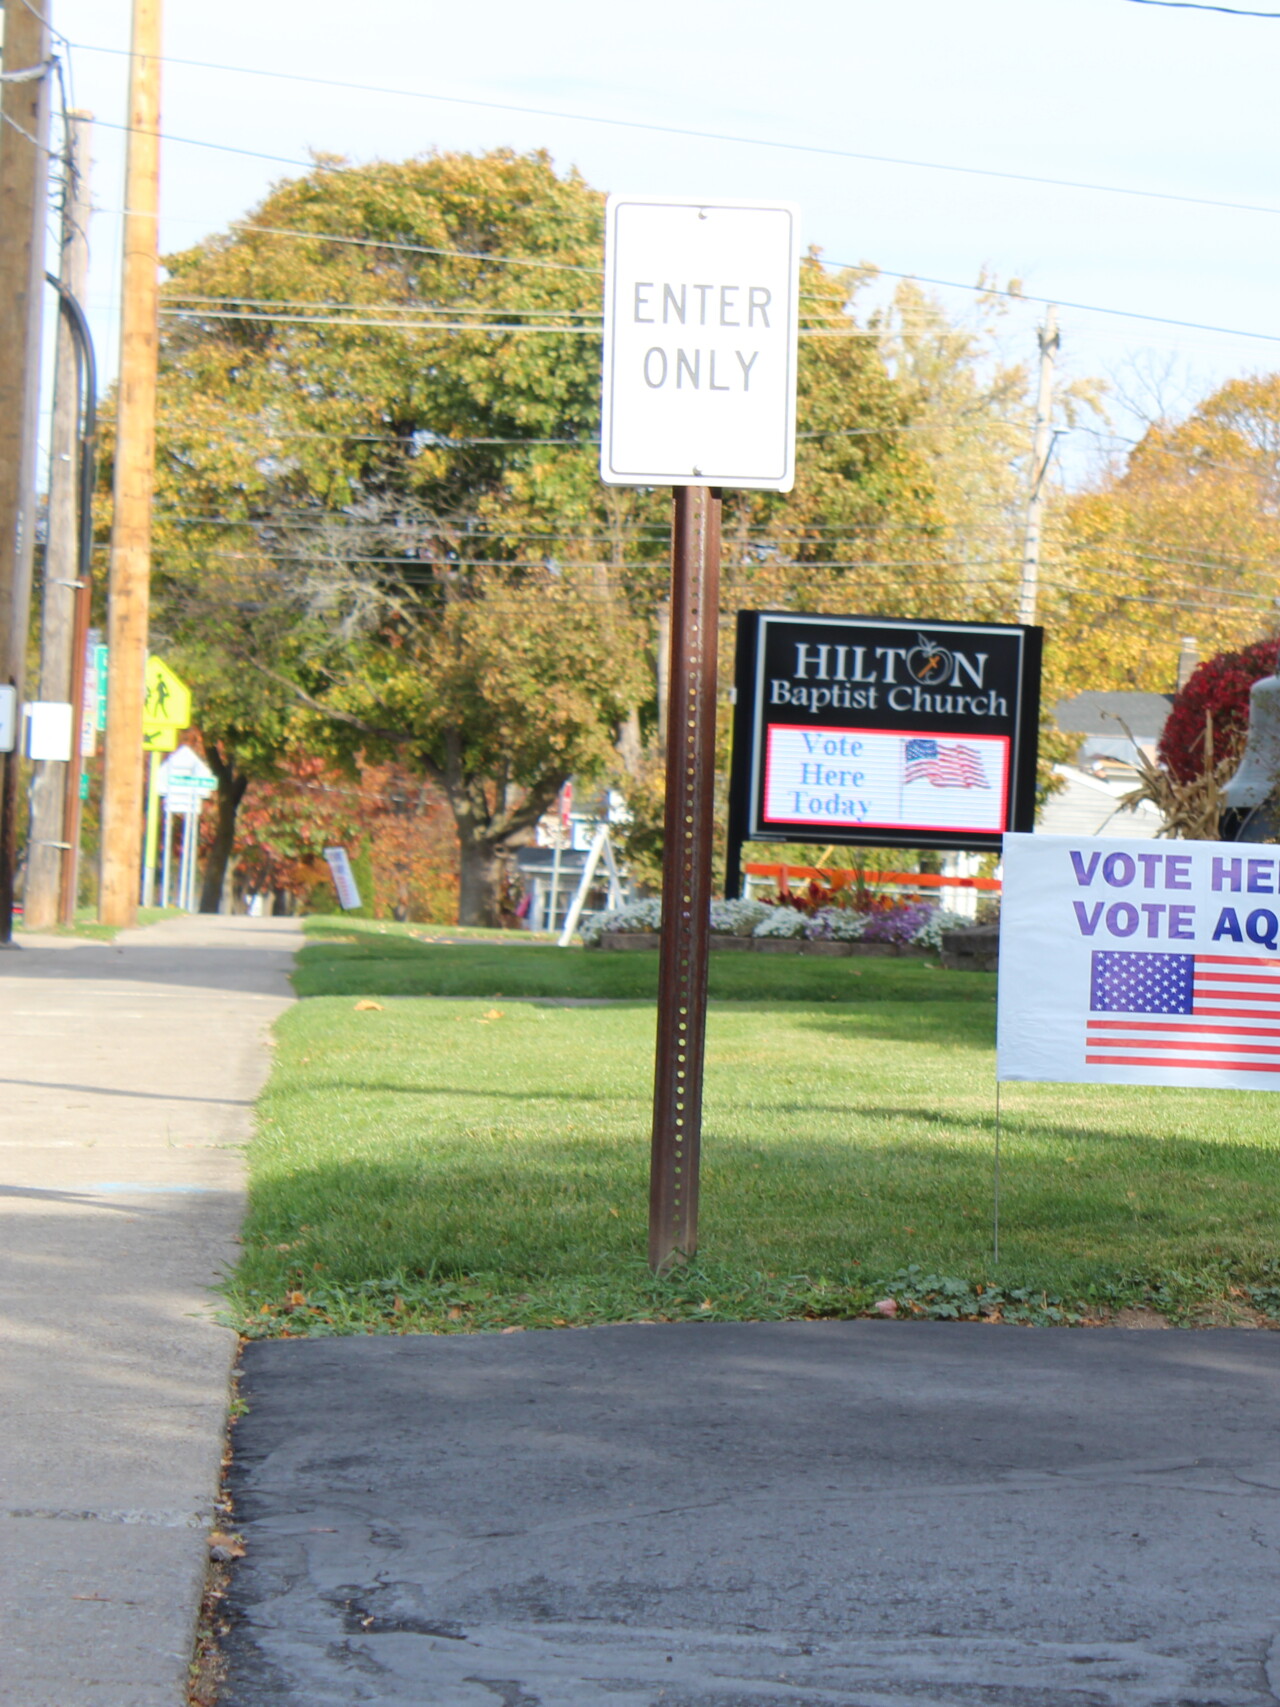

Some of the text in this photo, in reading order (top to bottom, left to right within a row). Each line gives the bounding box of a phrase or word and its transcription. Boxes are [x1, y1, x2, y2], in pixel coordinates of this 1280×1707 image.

[634, 282, 772, 328] ENTER
[643, 346, 759, 391] ONLY
[770, 679, 1009, 717] Baptist Church
[801, 732, 864, 757] Vote
[799, 762, 866, 787] Here
[787, 791, 872, 823] Today
[1069, 850, 1192, 890] VOTE
[1073, 901, 1196, 939] VOTE
